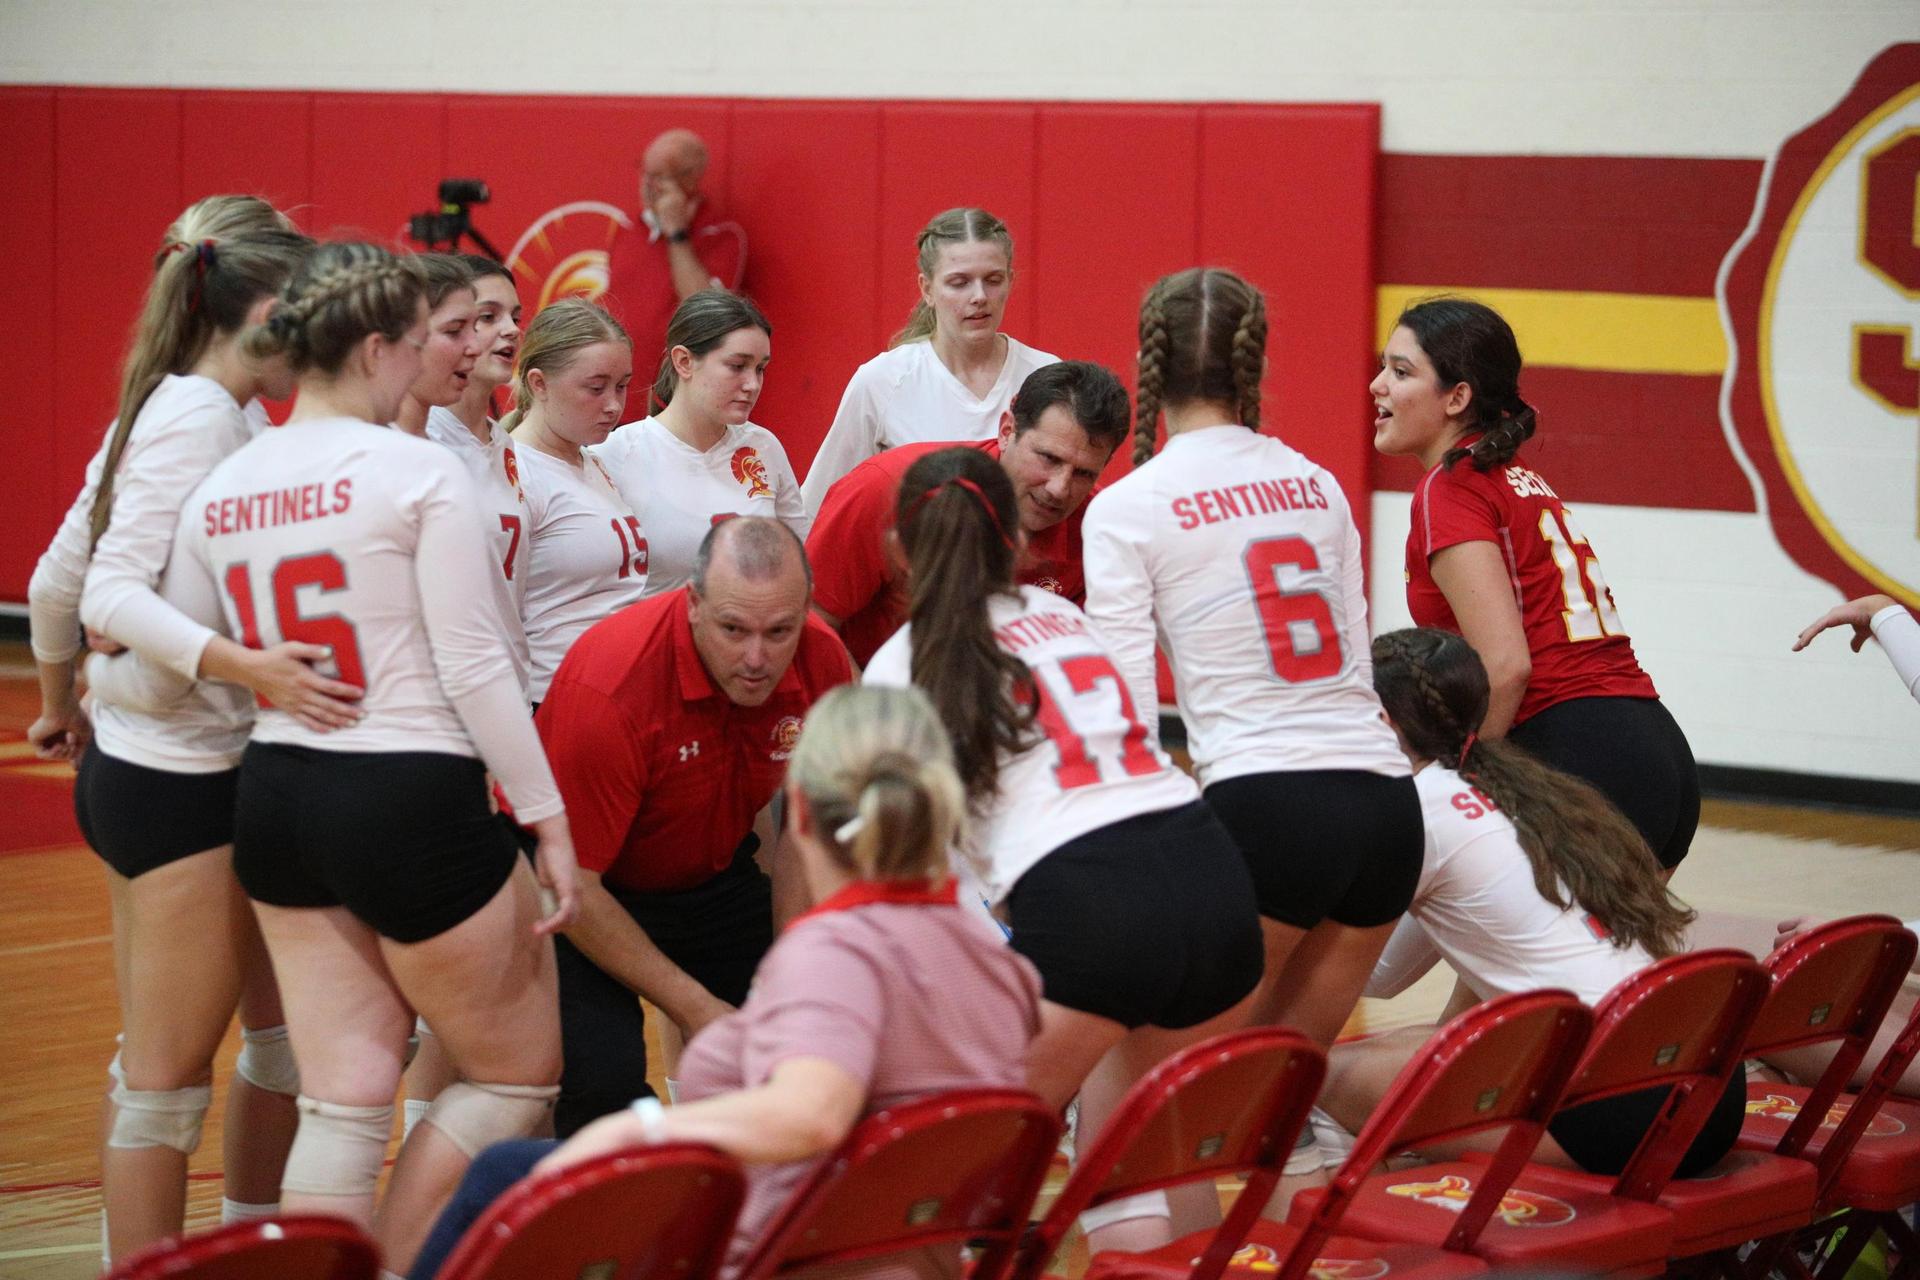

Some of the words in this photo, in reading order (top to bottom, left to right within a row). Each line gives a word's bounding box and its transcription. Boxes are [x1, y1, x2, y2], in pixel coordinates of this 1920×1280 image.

[204, 477, 353, 538] SENTINELS
[1171, 476, 1329, 531] SENTINELS
[498, 513, 522, 581] 7
[610, 515, 649, 580] 15
[224, 547, 369, 711] 16
[1241, 532, 1345, 685] 6
[1012, 653, 1165, 792] 17
